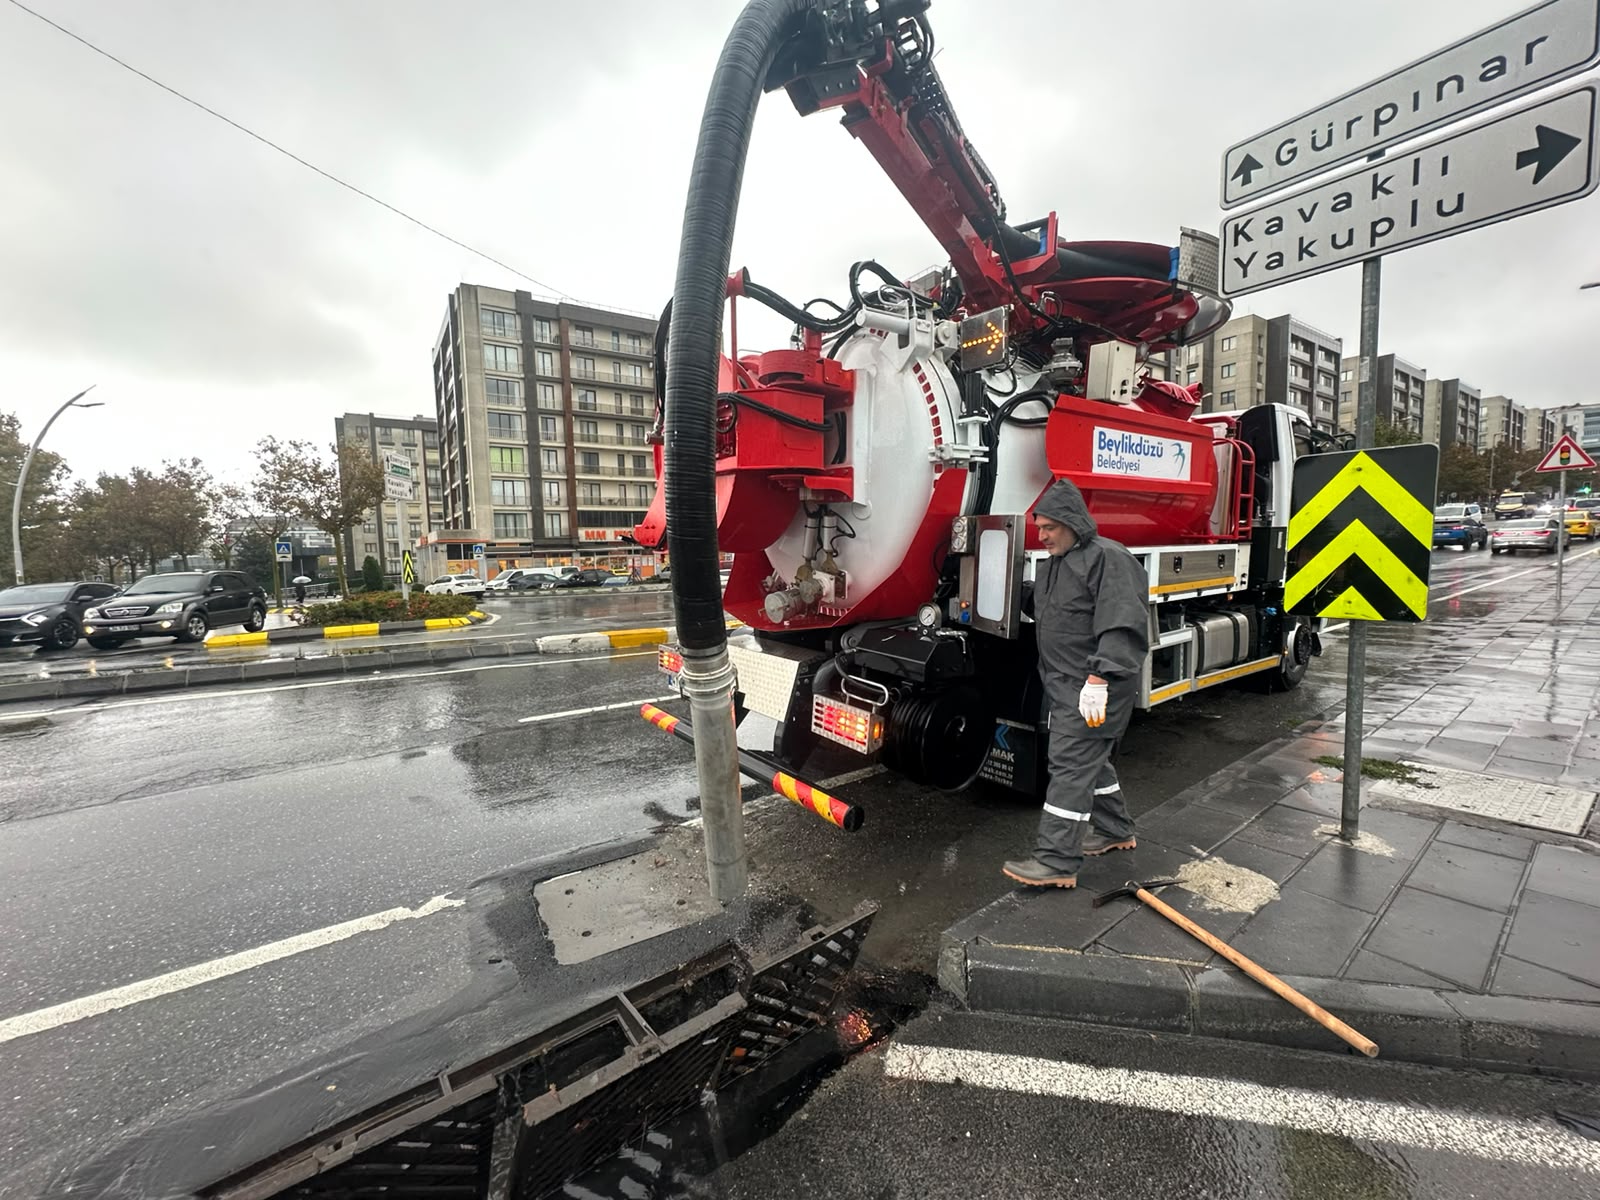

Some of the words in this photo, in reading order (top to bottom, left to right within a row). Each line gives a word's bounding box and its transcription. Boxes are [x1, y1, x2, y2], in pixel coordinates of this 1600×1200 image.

[1275, 36, 1549, 167] Gürpınar
[1233, 155, 1449, 247] Kavaklı
[1233, 193, 1465, 279] Yakuplu
[1097, 454, 1140, 473] Belediyesi
[1098, 430, 1164, 458] Beylikdüzü
